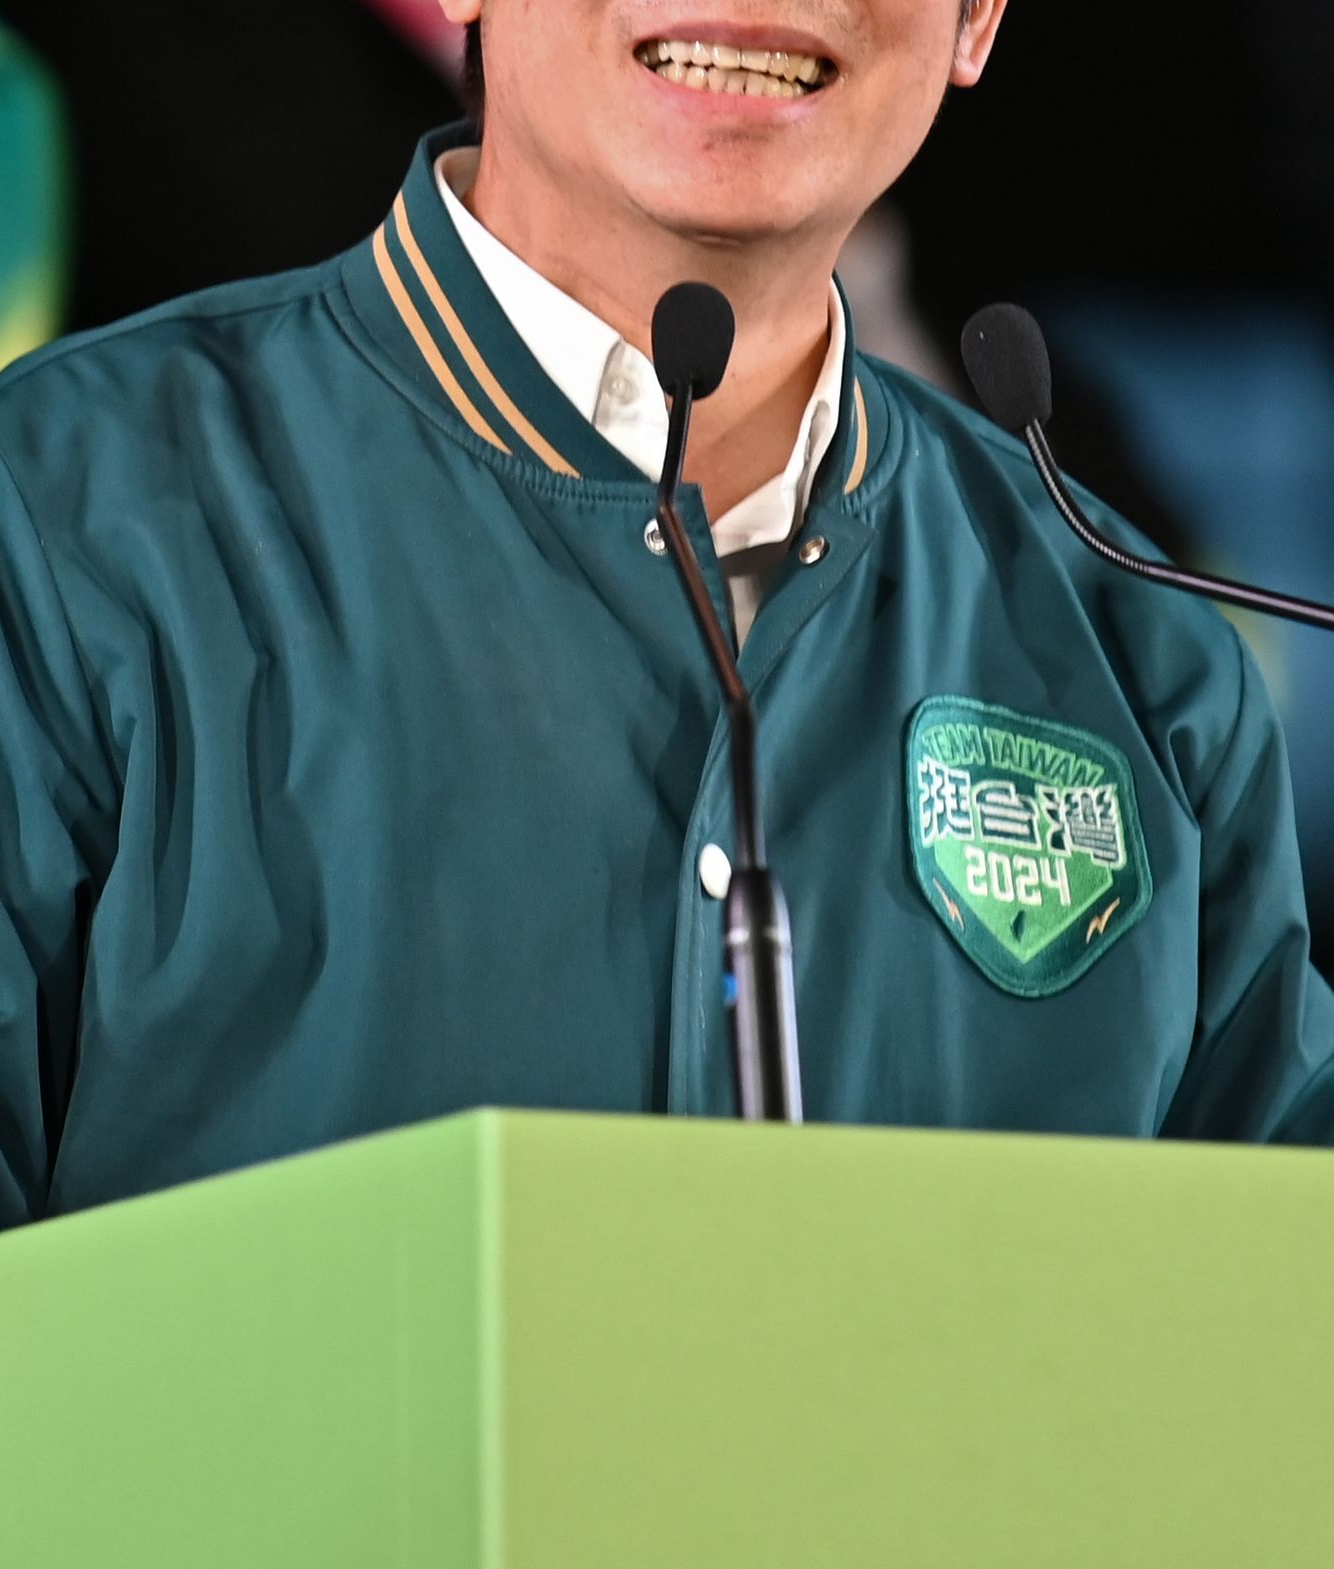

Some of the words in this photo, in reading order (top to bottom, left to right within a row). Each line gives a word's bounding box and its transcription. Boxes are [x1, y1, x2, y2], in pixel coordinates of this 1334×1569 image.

[923, 723, 985, 765] TEAM
[983, 726, 1105, 787] TAIWAN
[917, 758, 1127, 870] 挺台灣
[964, 844, 1072, 907] 2024
